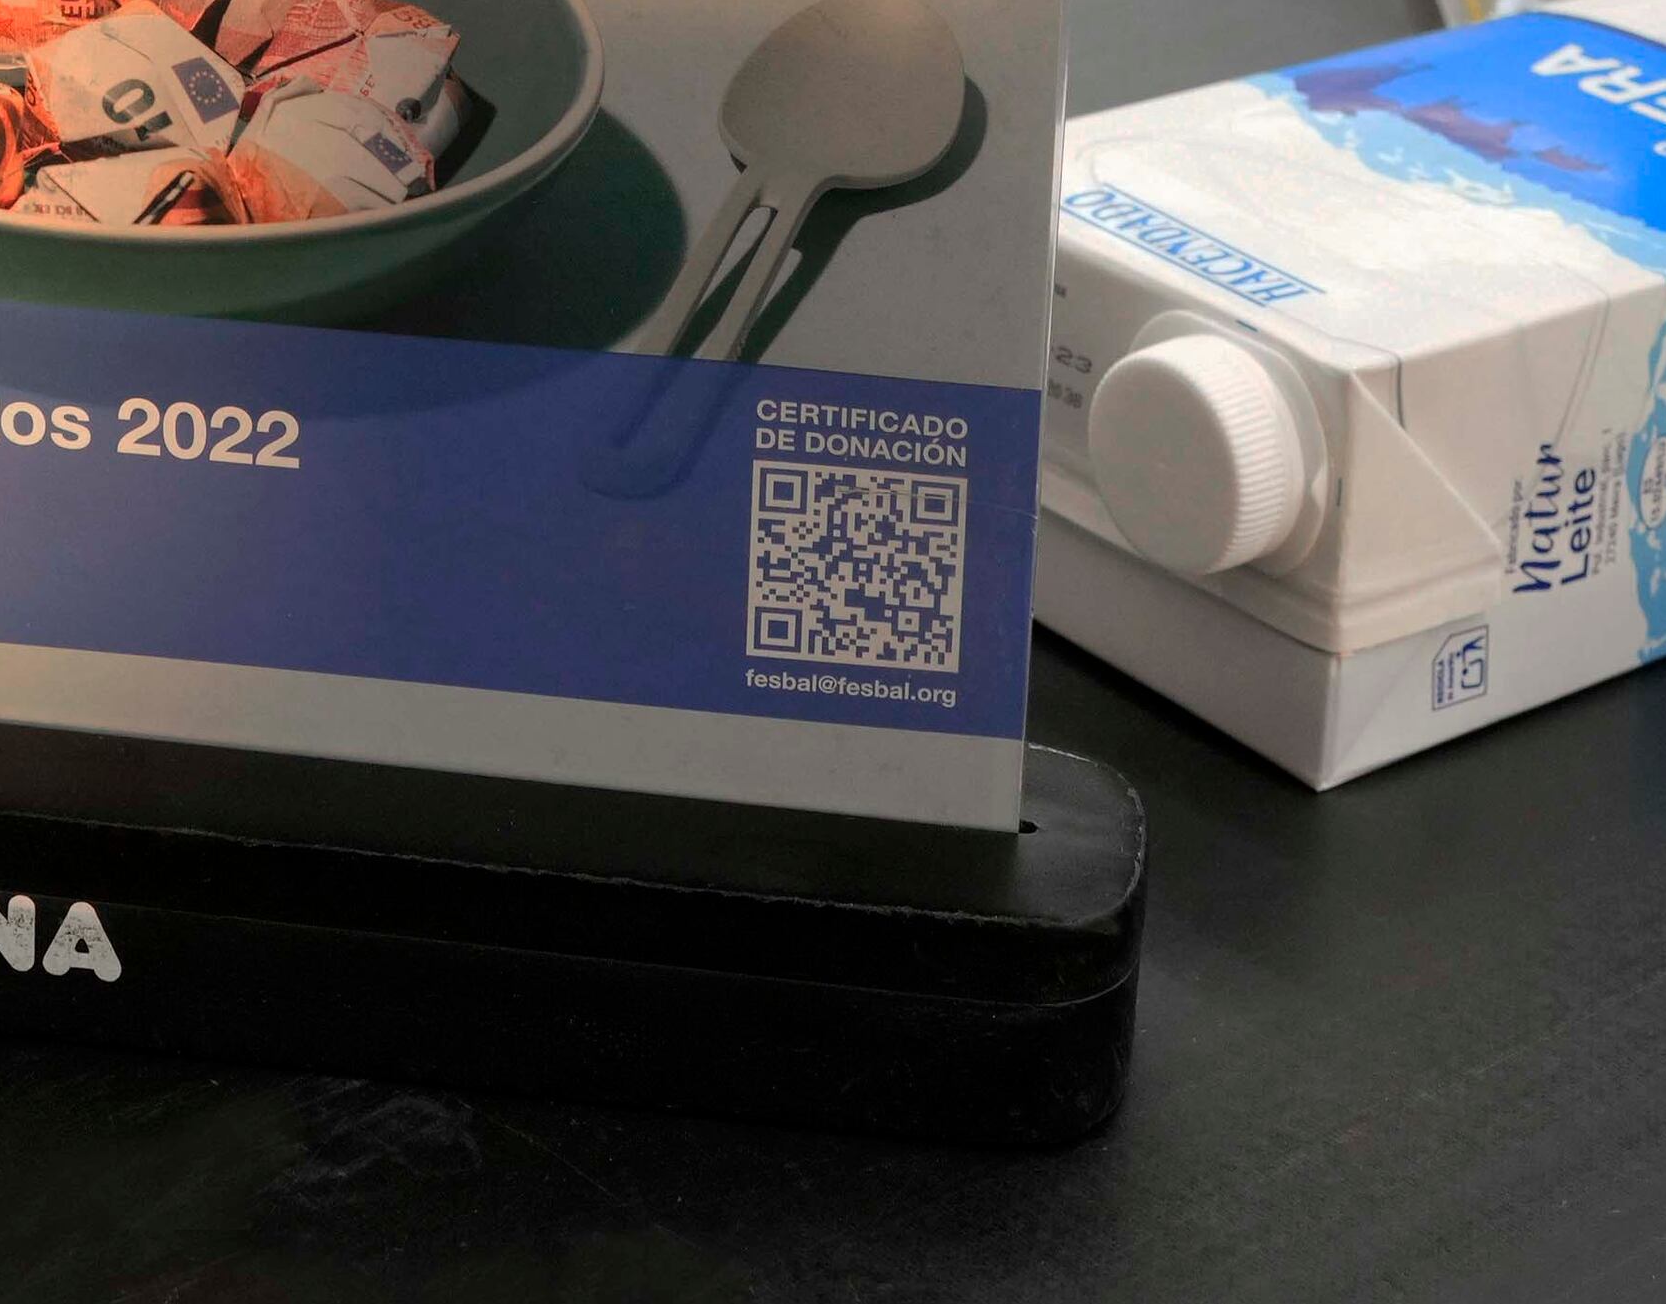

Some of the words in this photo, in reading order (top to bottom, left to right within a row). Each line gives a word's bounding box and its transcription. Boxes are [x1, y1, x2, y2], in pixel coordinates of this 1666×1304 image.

[1064, 189, 1311, 304] HACENDADO
[116, 397, 301, 470] 2022
[755, 427, 795, 453] DE
[805, 430, 968, 468] DONACIÓN
[756, 399, 969, 440] CERTIFICADO
[1559, 467, 1596, 586] Leite
[745, 668, 958, 709] fesbal@fesbal.org
